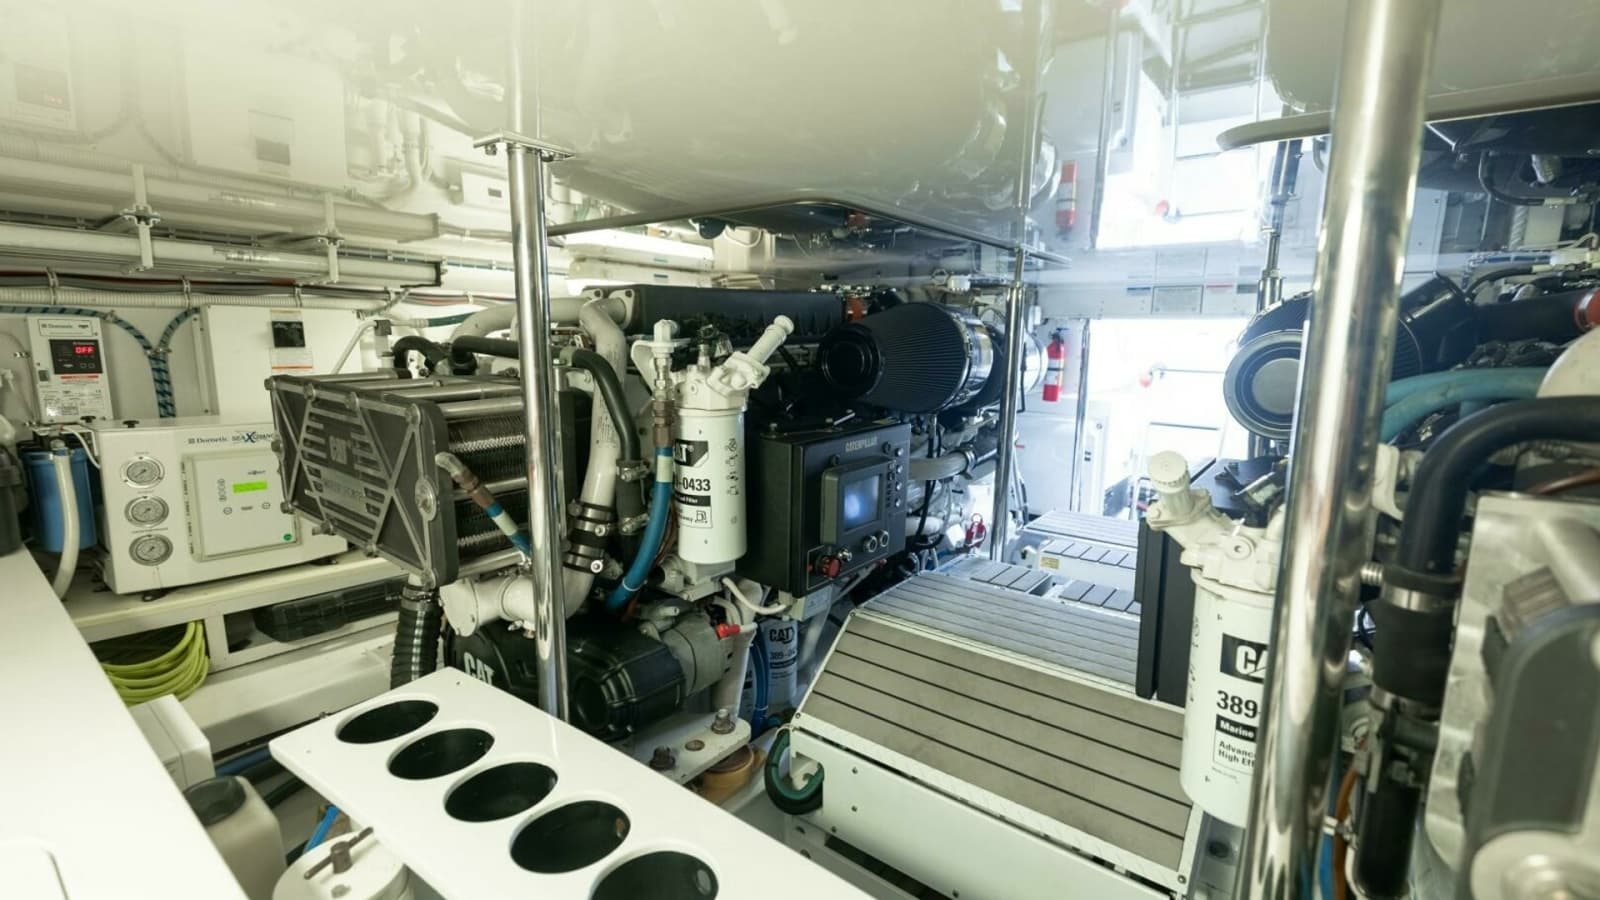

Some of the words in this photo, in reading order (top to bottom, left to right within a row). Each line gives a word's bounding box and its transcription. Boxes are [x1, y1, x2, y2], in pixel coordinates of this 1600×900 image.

[75, 345, 95, 355] OFF
[769, 628, 792, 642] CAT
[463, 651, 495, 687] CAT
[1219, 721, 1255, 739] Marine
[1218, 749, 1240, 764] High
